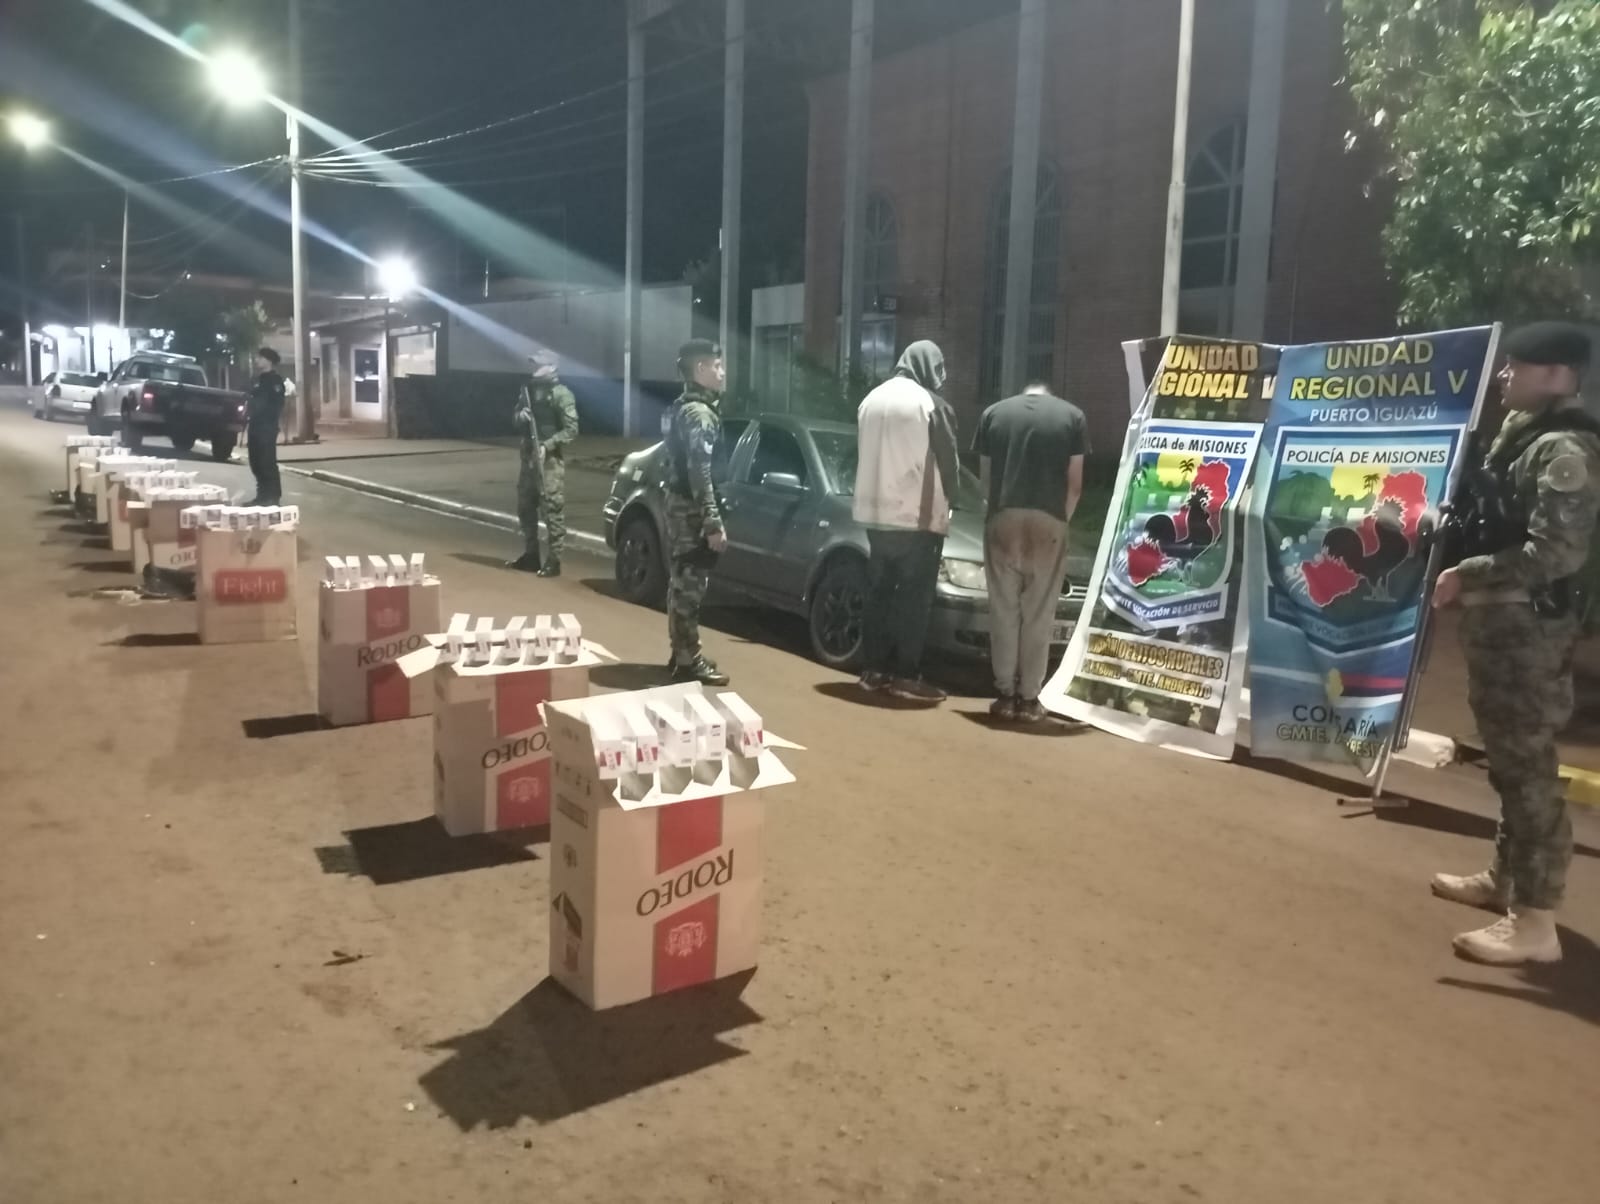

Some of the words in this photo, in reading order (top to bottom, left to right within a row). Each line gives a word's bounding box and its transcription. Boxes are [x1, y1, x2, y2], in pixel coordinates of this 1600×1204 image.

[1164, 344, 1259, 371] UNIDAD
[1326, 340, 1434, 370] UNIDAD
[1153, 371, 1249, 399] GIONAL
[1289, 372, 1436, 400] REGIONAL
[1448, 369, 1468, 394] V
[1310, 408, 1370, 422] PUERTO
[1374, 402, 1438, 422] IGUAZÚ
[1171, 437, 1185, 450] de
[1188, 439, 1247, 455] MISIONES
[1287, 448, 1344, 464] POLICÍA
[1350, 451, 1369, 464] DE
[1372, 450, 1446, 464] MISIONES
[1183, 600, 1218, 613] SERVICIO
[357, 634, 421, 667] RODEO
[1118, 640, 1167, 667] DELITOS
[1166, 648, 1223, 679] RURALES
[1157, 673, 1213, 700] ANDRESITO
[482, 731, 552, 769] ODEO
[636, 848, 734, 917] RODEO
